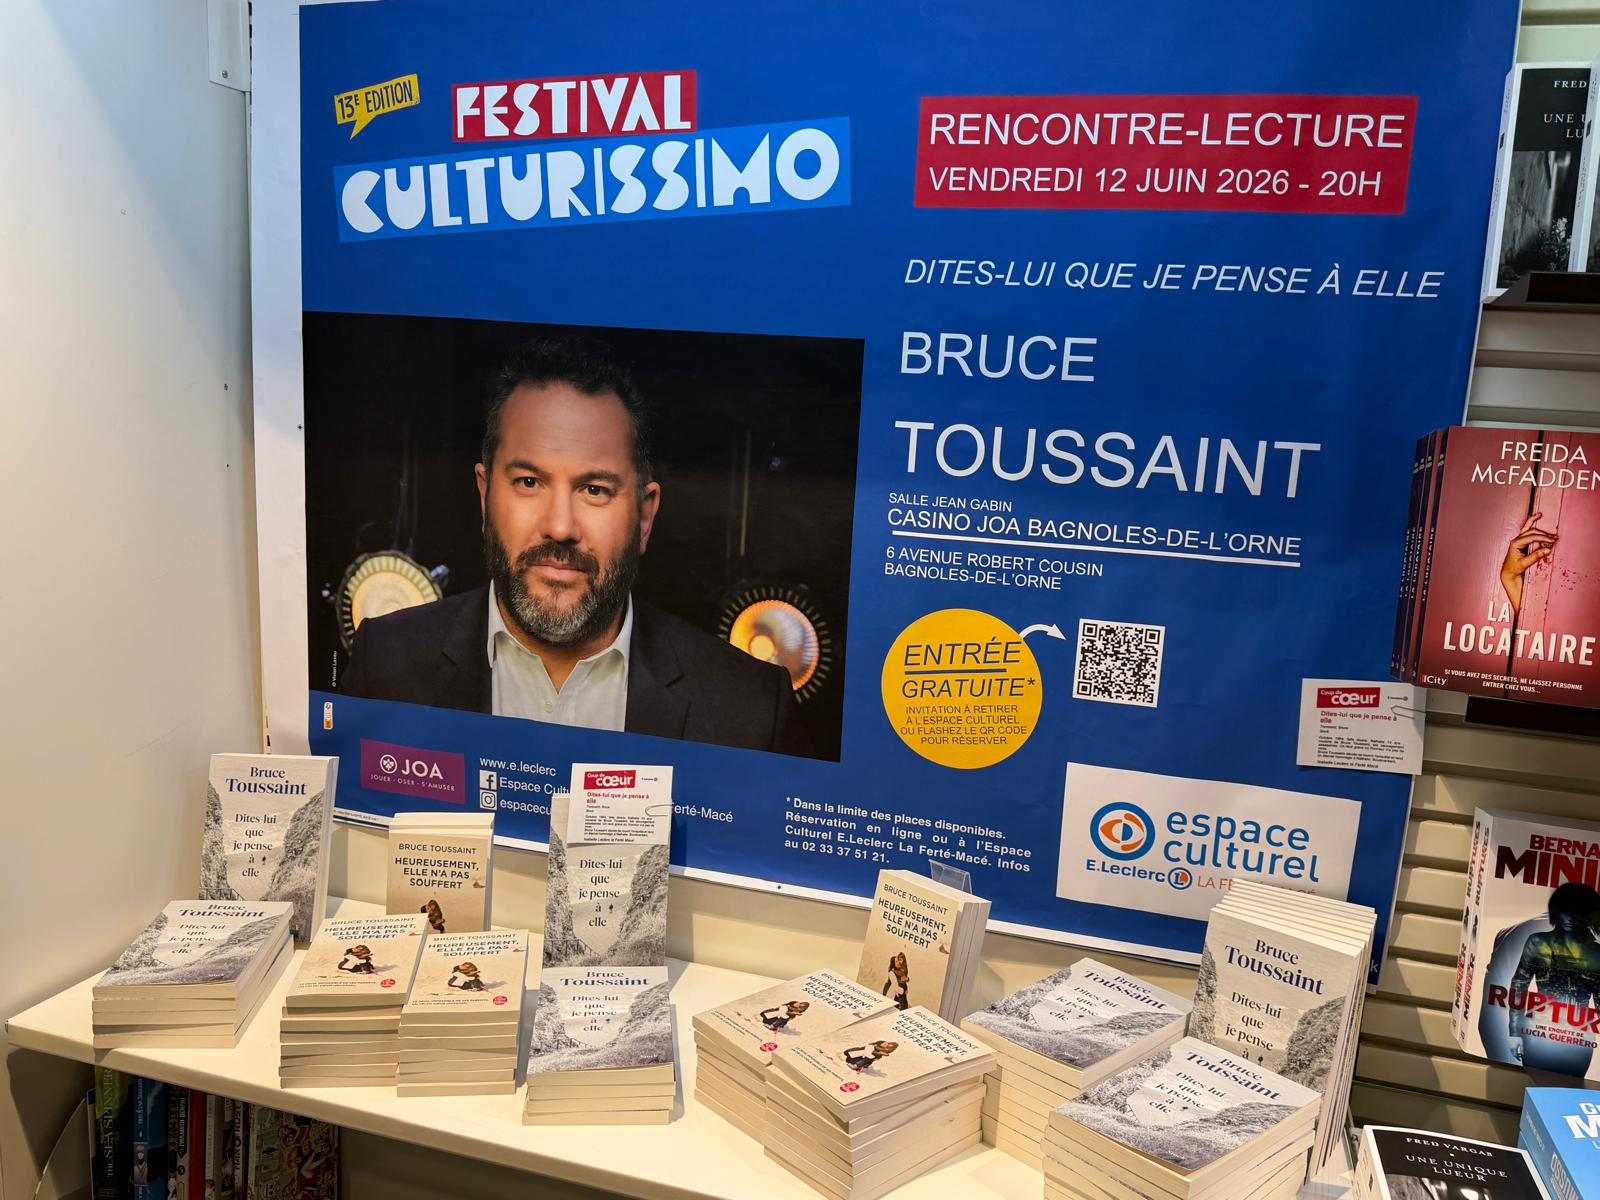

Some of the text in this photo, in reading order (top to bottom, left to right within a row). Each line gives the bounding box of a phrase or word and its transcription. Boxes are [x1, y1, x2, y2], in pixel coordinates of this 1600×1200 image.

[1554, 80, 1587, 88] FRED
[364, 79, 415, 114] EDITION
[457, 74, 692, 139] FESTIVAL
[1544, 113, 1574, 124] UNE
[930, 113, 1405, 148] RENCONTRE-LECTURE
[341, 127, 840, 233] CULTURISSIMO
[929, 167, 1380, 197] VENDREDI 12 JUIN 2026 20H
[904, 259, 1445, 299] DITES-LUI QUE JE PENSE À ELLE
[900, 331, 1098, 382] BRUCE
[894, 420, 1321, 498] TOUSSAINT
[1501, 440, 1588, 465] FREIDA
[889, 492, 1012, 512] SALLE JEAN GABIN
[888, 508, 1301, 556] CASINO JOA BAGNOLES-DE-L'ORNE
[886, 546, 1103, 576] 6 AVENUE ROBERT COUSIN
[885, 563, 1061, 589] BAGNOLES-DE-L'ORNE
[1487, 600, 1511, 623] LA
[904, 636, 1022, 666] ENTRÉE
[1443, 622, 1596, 666] LOCATAIRE
[1493, 675, 1519, 683] SECRETS,
[1529, 679, 1552, 687] LAISSEZ
[1553, 681, 1583, 690] PERSONNE
[906, 704, 1018, 714] INVITATION À RETIRER
[906, 715, 1020, 725] À L'ESPACE CULTUREL
[901, 726, 1027, 735] OU FLASHEZ LE QR CODE
[921, 735, 1008, 745] POUR RÉSERVER
[250, 766, 286, 779] Bruce
[401, 759, 443, 779] JOA
[480, 757, 556, 777] www.e.leclerc
[225, 778, 308, 796] Toussaint
[371, 774, 391, 782] JOUER
[421, 782, 455, 791] S'AMUSER
[500, 777, 540, 792] Espace
[235, 813, 276, 824] Dites-lui
[672, 802, 733, 822] erté-Macé
[793, 798, 1006, 840] Dans la limite des places disponibles.
[245, 829, 264, 838] que
[786, 811, 1032, 858] Réservation en ligne ou à l'Espace
[1167, 811, 1310, 851] espace
[233, 841, 273, 852] je pense
[399, 843, 477, 855] BRUCE TOUSSAINT
[785, 825, 1031, 872] Culturel E.Leclerc La Ferté-Macé. Infos
[785, 839, 890, 864] au 02 33 37 51 21.
[249, 855, 255, 864] à
[395, 857, 479, 871] HEUREUSEMENT,
[579, 859, 623, 869] Dites-lui
[1163, 840, 1319, 884] culturel
[1495, 845, 1600, 892] MINI
[242, 868, 260, 877] elle
[404, 867, 470, 879] ELLE N'A PAS
[410, 878, 463, 889] SOUFFERT
[590, 875, 610, 885] que
[1086, 859, 1165, 883] E.Leclerc
[1197, 876, 1215, 889] LA
[578, 889, 620, 900] je pense
[884, 884, 948, 916] BRUCE TOUSSAINT
[595, 903, 602, 912] à
[878, 898, 948, 935] HEUREUSEMENT,
[589, 918, 607, 927] elle
[882, 912, 938, 941] ELLE N'A PAS
[886, 923, 931, 949] SOUFFERT
[1255, 938, 1299, 965] Bruce
[1225, 945, 1325, 995] Toussaint
[1231, 991, 1281, 1019] Dites-lui
[1241, 1014, 1265, 1031] que
[1548, 1027, 1574, 1036] ENQUÊTE
[1225, 1023, 1274, 1052] je pense
[1520, 1027, 1598, 1049] LUCIA GUERRERO
[1241, 1047, 1250, 1059] à
[1185, 1052, 1281, 1102] Toussaint
[1218, 1056, 1264, 1081] Bruce
[1406, 1137, 1493, 1157] FRED VARGAS
[1405, 1155, 1508, 1178] UNE UNIQUE
[1433, 1167, 1487, 1183] LUEUR
